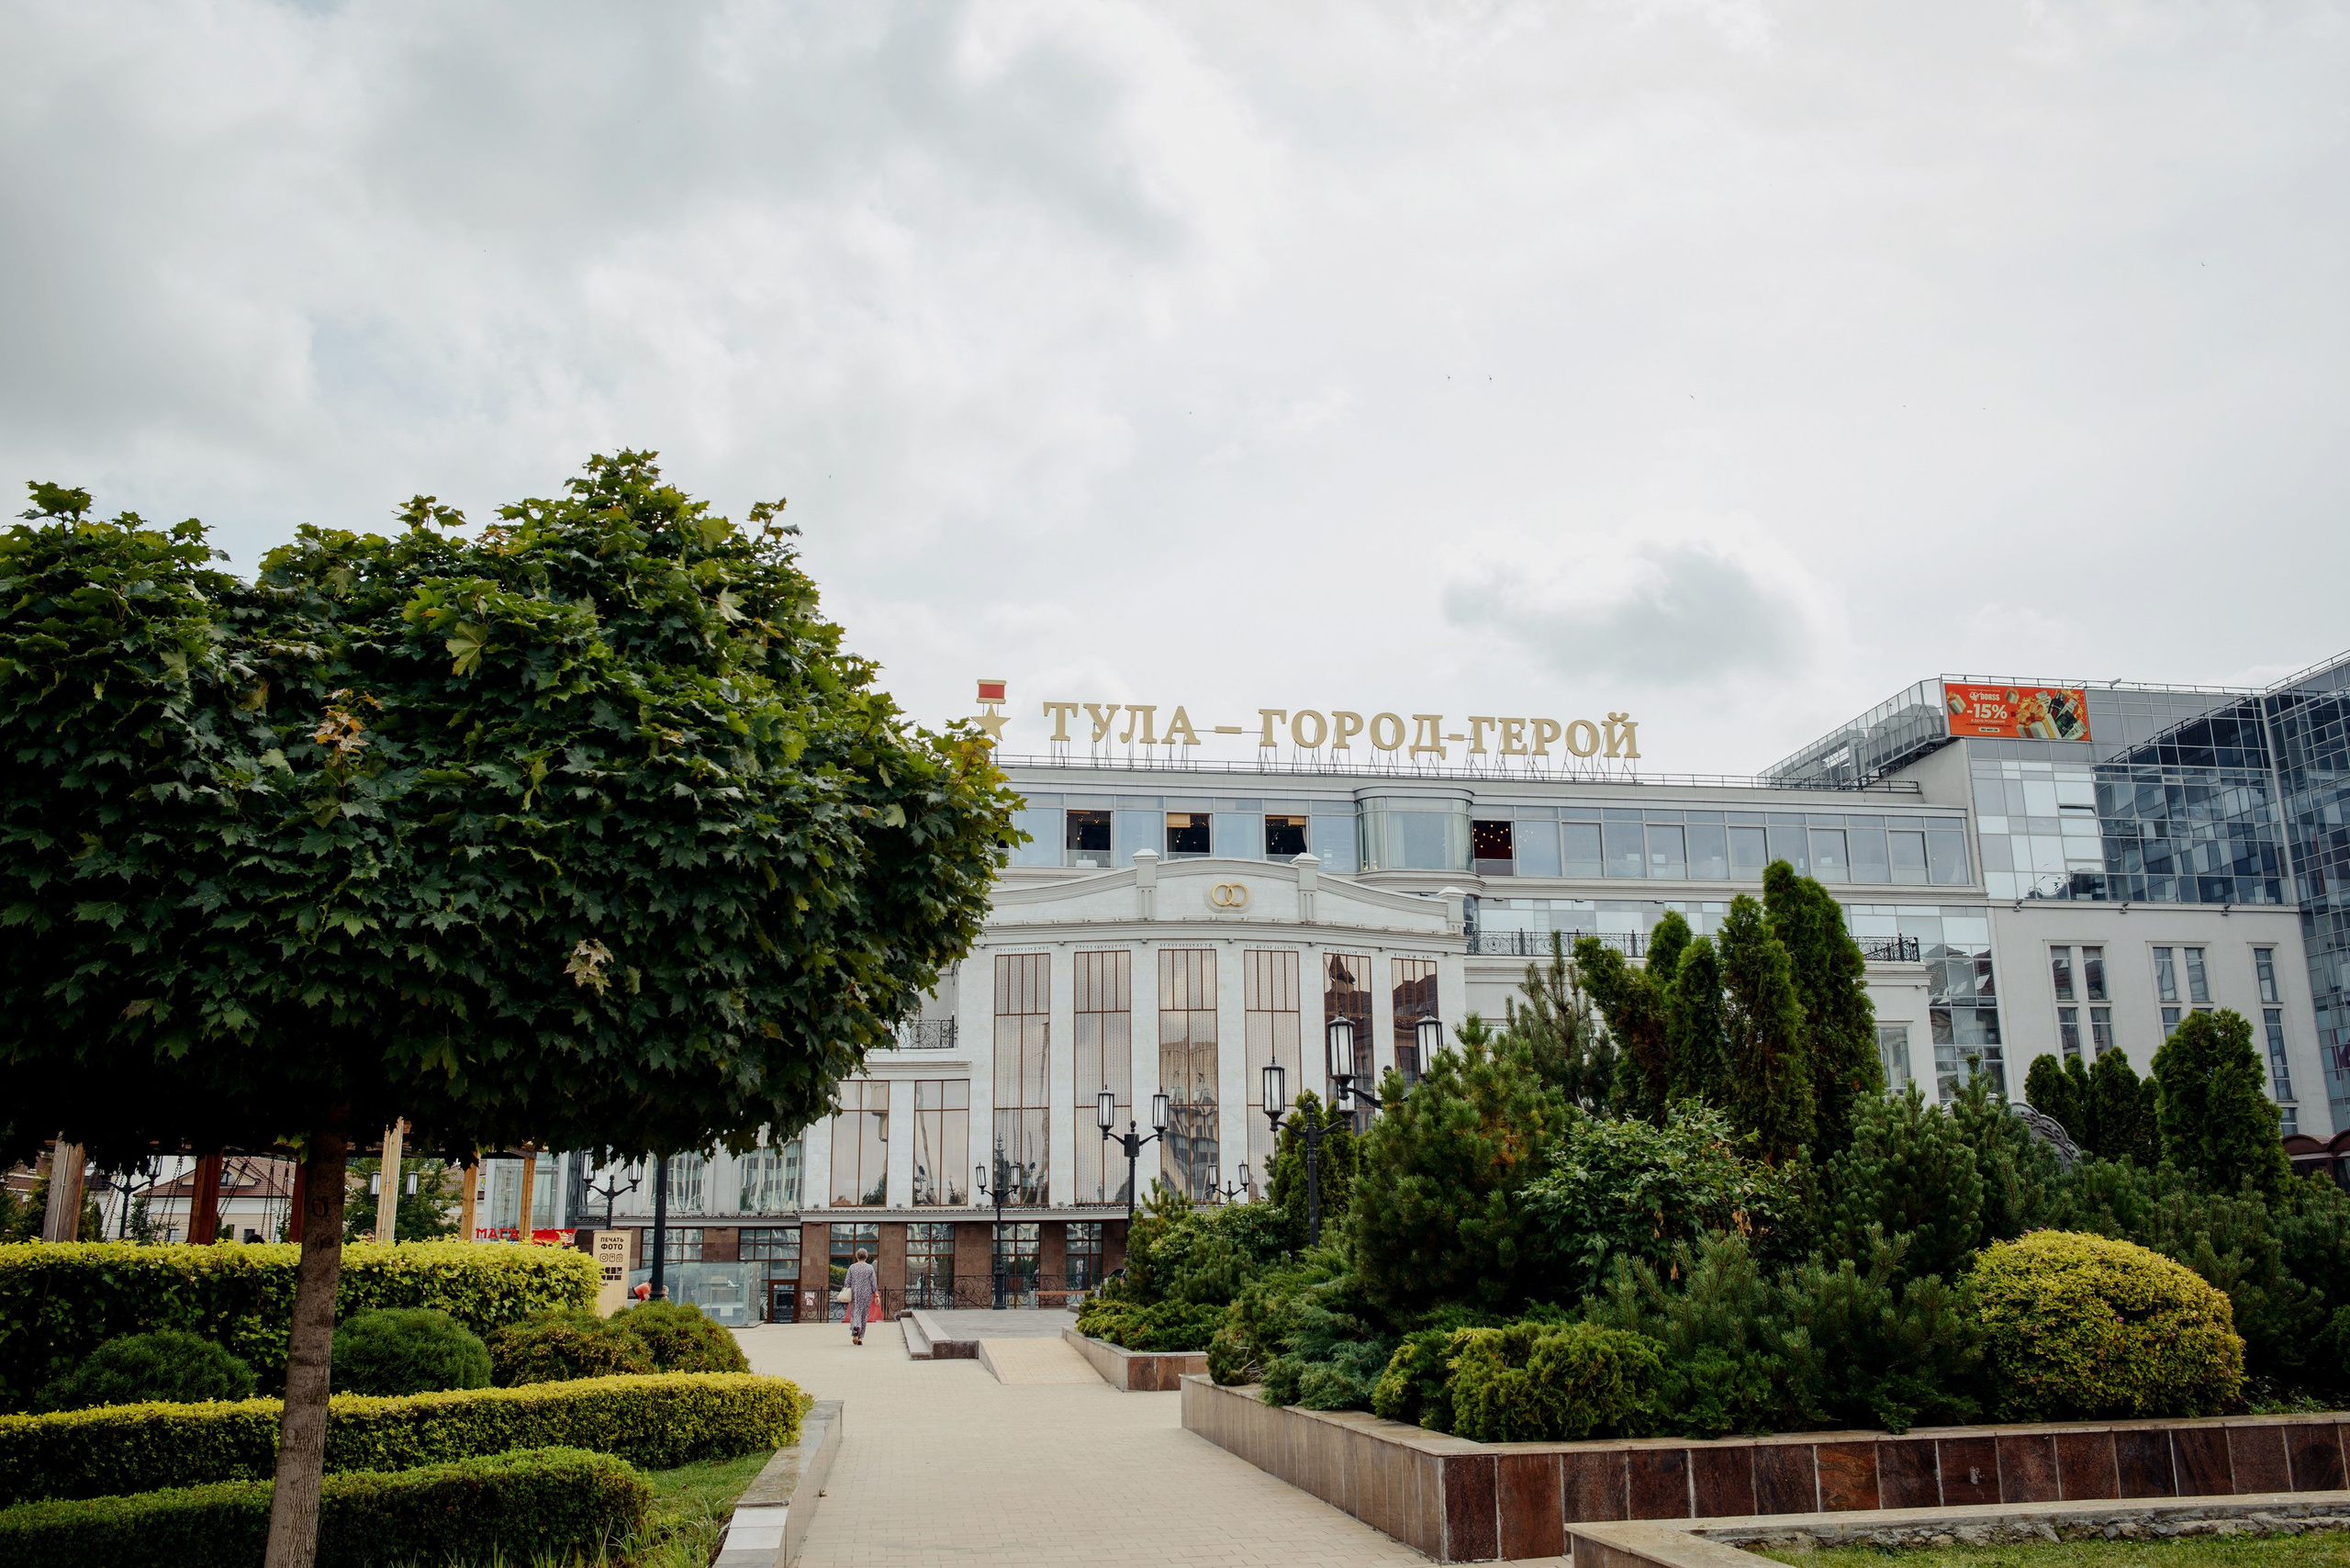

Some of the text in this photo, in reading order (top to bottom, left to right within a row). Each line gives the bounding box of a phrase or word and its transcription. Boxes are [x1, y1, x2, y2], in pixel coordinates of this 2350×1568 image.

[1966, 703, 2008, 719] -15%
[1043, 701, 1201, 745] ТУЛА
[1258, 708, 1641, 760] ГОРОД-ГЕРОЙ
